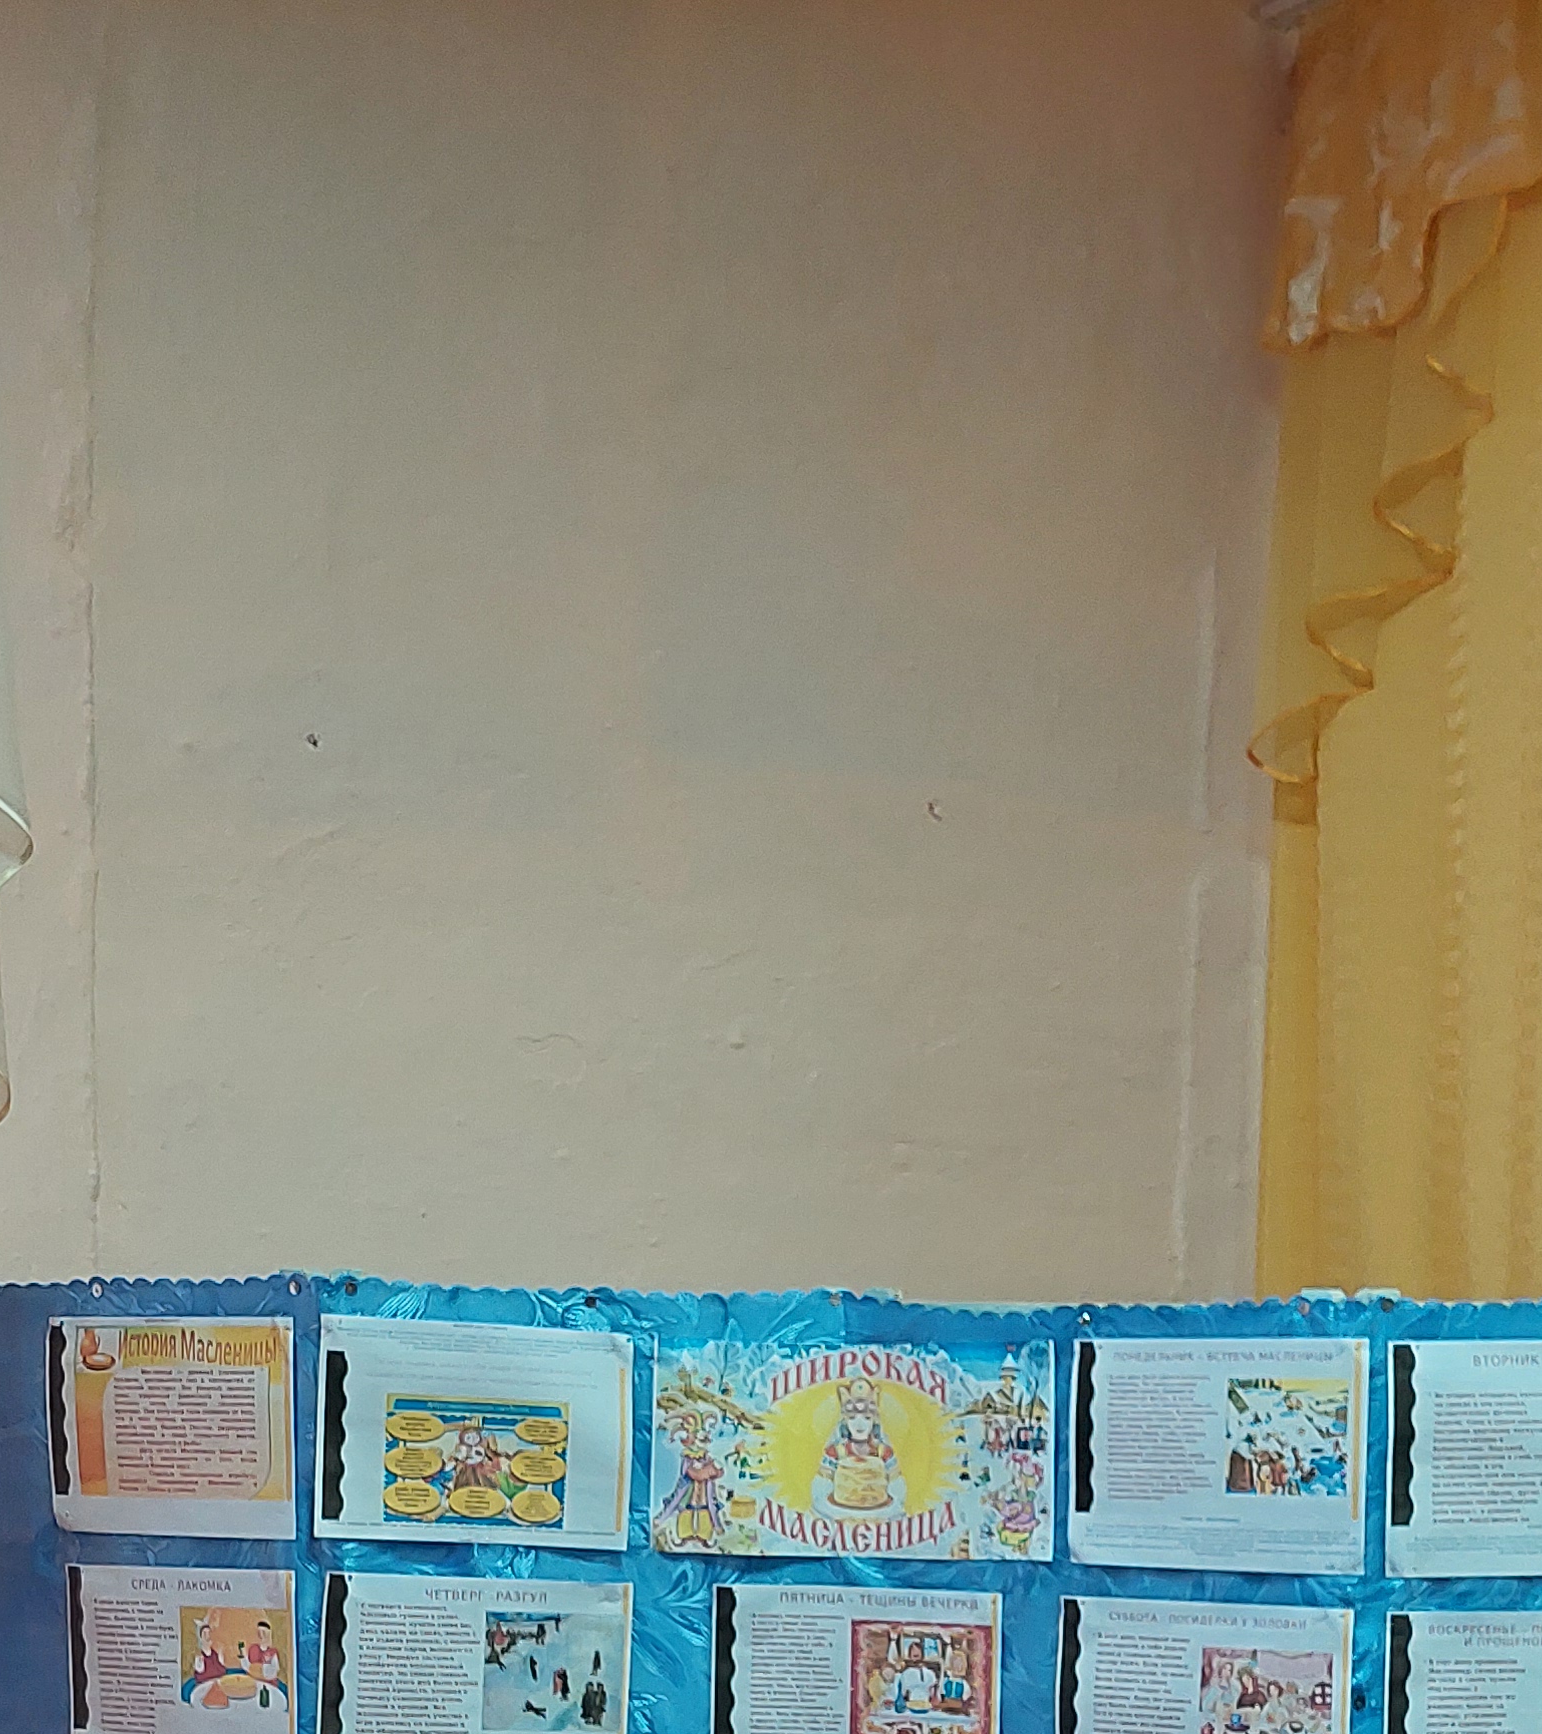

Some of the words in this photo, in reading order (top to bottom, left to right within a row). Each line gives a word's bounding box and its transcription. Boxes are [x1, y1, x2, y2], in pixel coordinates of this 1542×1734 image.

[119, 1329, 177, 1361] История
[181, 1328, 276, 1367] Масленицы
[1473, 1354, 1539, 1367] ВТОРНИК
[771, 1349, 947, 1403] ШИРОКАЯ
[759, 1498, 956, 1552] МАСЛЕНИЦА
[131, 1578, 166, 1590] СРЕДА
[177, 1580, 231, 1592] ЛАКОМКА
[425, 1588, 482, 1601] ЧЕТВЕРГ
[496, 1590, 547, 1604] РАЗГУЛ
[779, 1592, 845, 1604] ПЯТНИЦА
